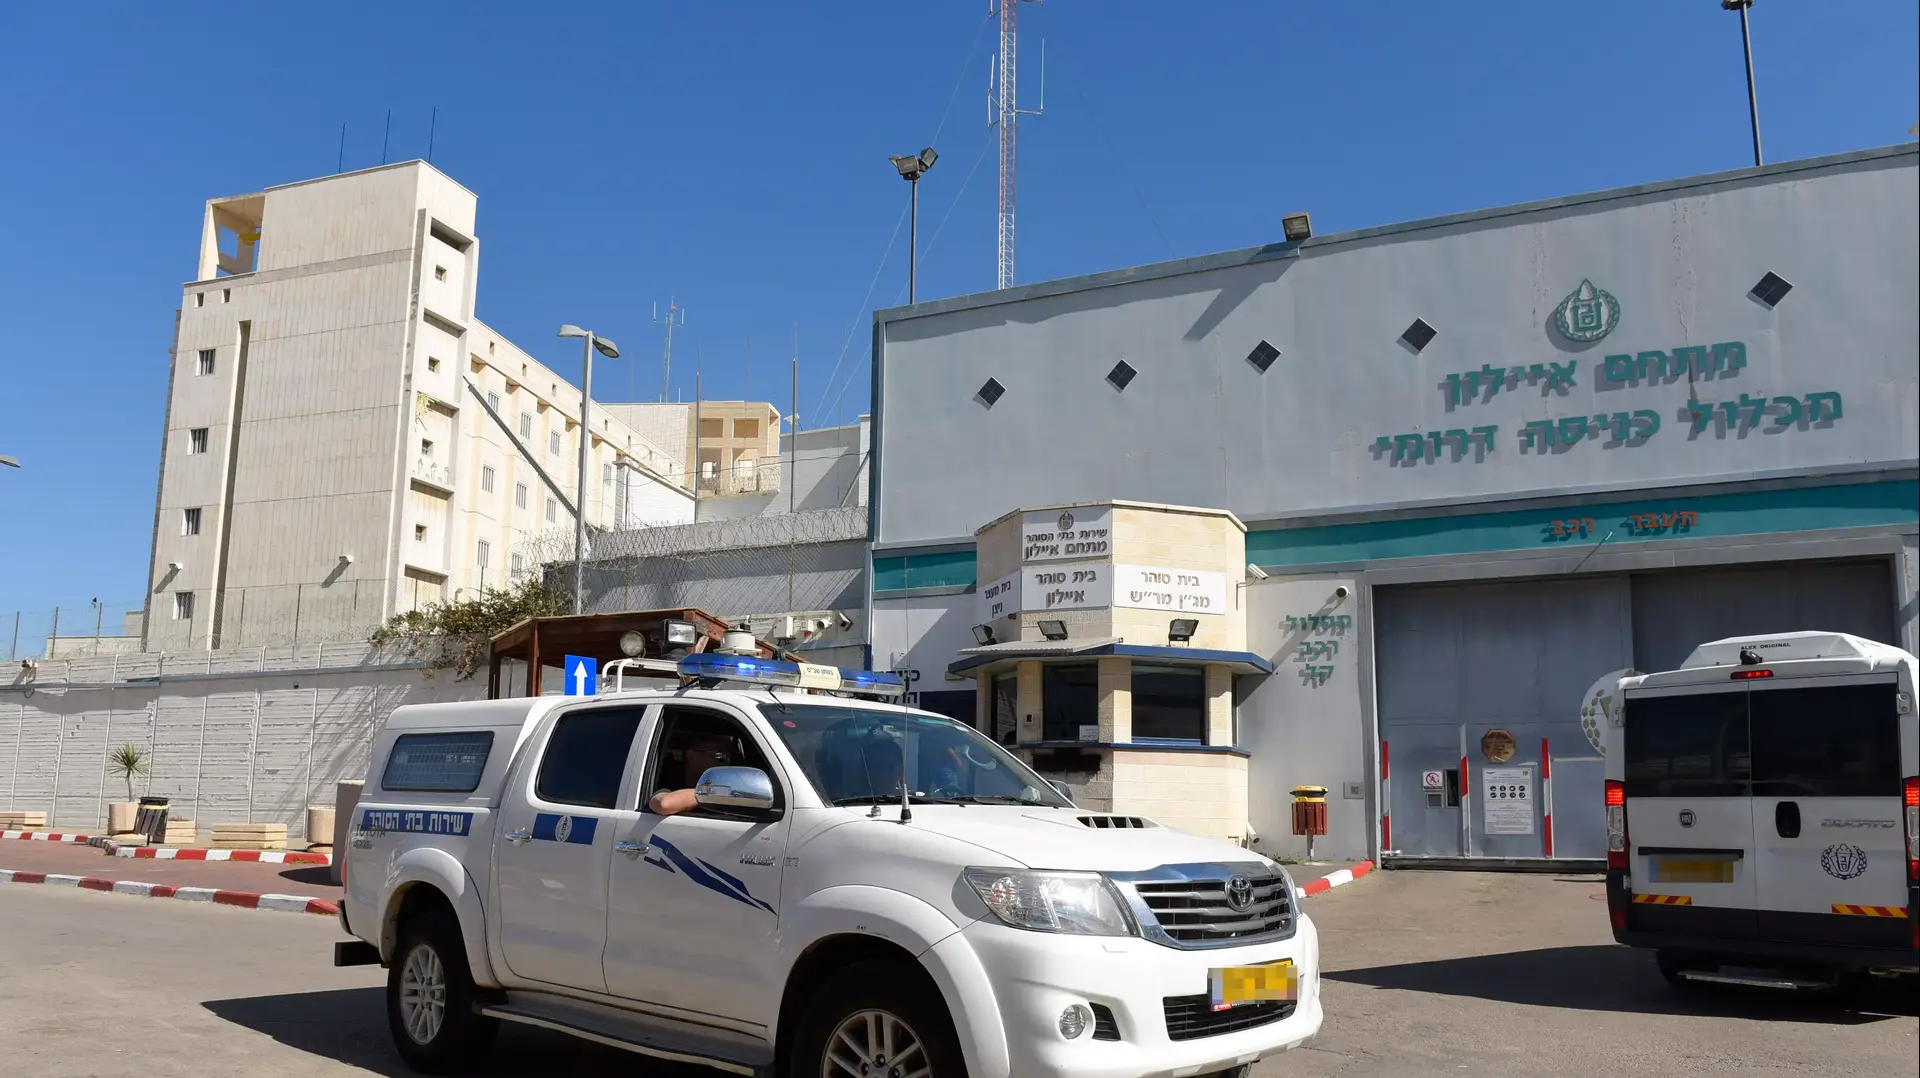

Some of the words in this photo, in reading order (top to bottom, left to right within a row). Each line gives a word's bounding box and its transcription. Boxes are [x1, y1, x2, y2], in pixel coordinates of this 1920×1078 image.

[1604, 341, 1747, 382] מתחם
[1446, 360, 1577, 405] איילון
[1687, 391, 1844, 432] מכלול
[1524, 409, 1660, 447] כניסה
[1375, 425, 1498, 460] דרומי
[1550, 517, 1595, 535] רכב
[1628, 511, 1698, 528] מעבר
[1025, 533, 1054, 542] הסוהר
[1057, 531, 1075, 540] בתי
[1079, 529, 1107, 539] שירות
[1025, 544, 1059, 560] איילון
[1065, 541, 1107, 554] מתחם
[1035, 572, 1066, 585] סוהר
[1072, 570, 1097, 583] בית
[1141, 571, 1171, 584] סוהר
[1177, 574, 1200, 586] בית
[1001, 580, 1011, 593] בית
[1046, 588, 1084, 608] איילון
[992, 602, 1003, 618] ניצן
[1286, 613, 1352, 631] מסלול
[1300, 640, 1338, 655] רכב
[1305, 664, 1334, 681] קל
[369, 811, 400, 830] הסוהר
[405, 812, 424, 831] בתי
[428, 813, 464, 833] שירות
